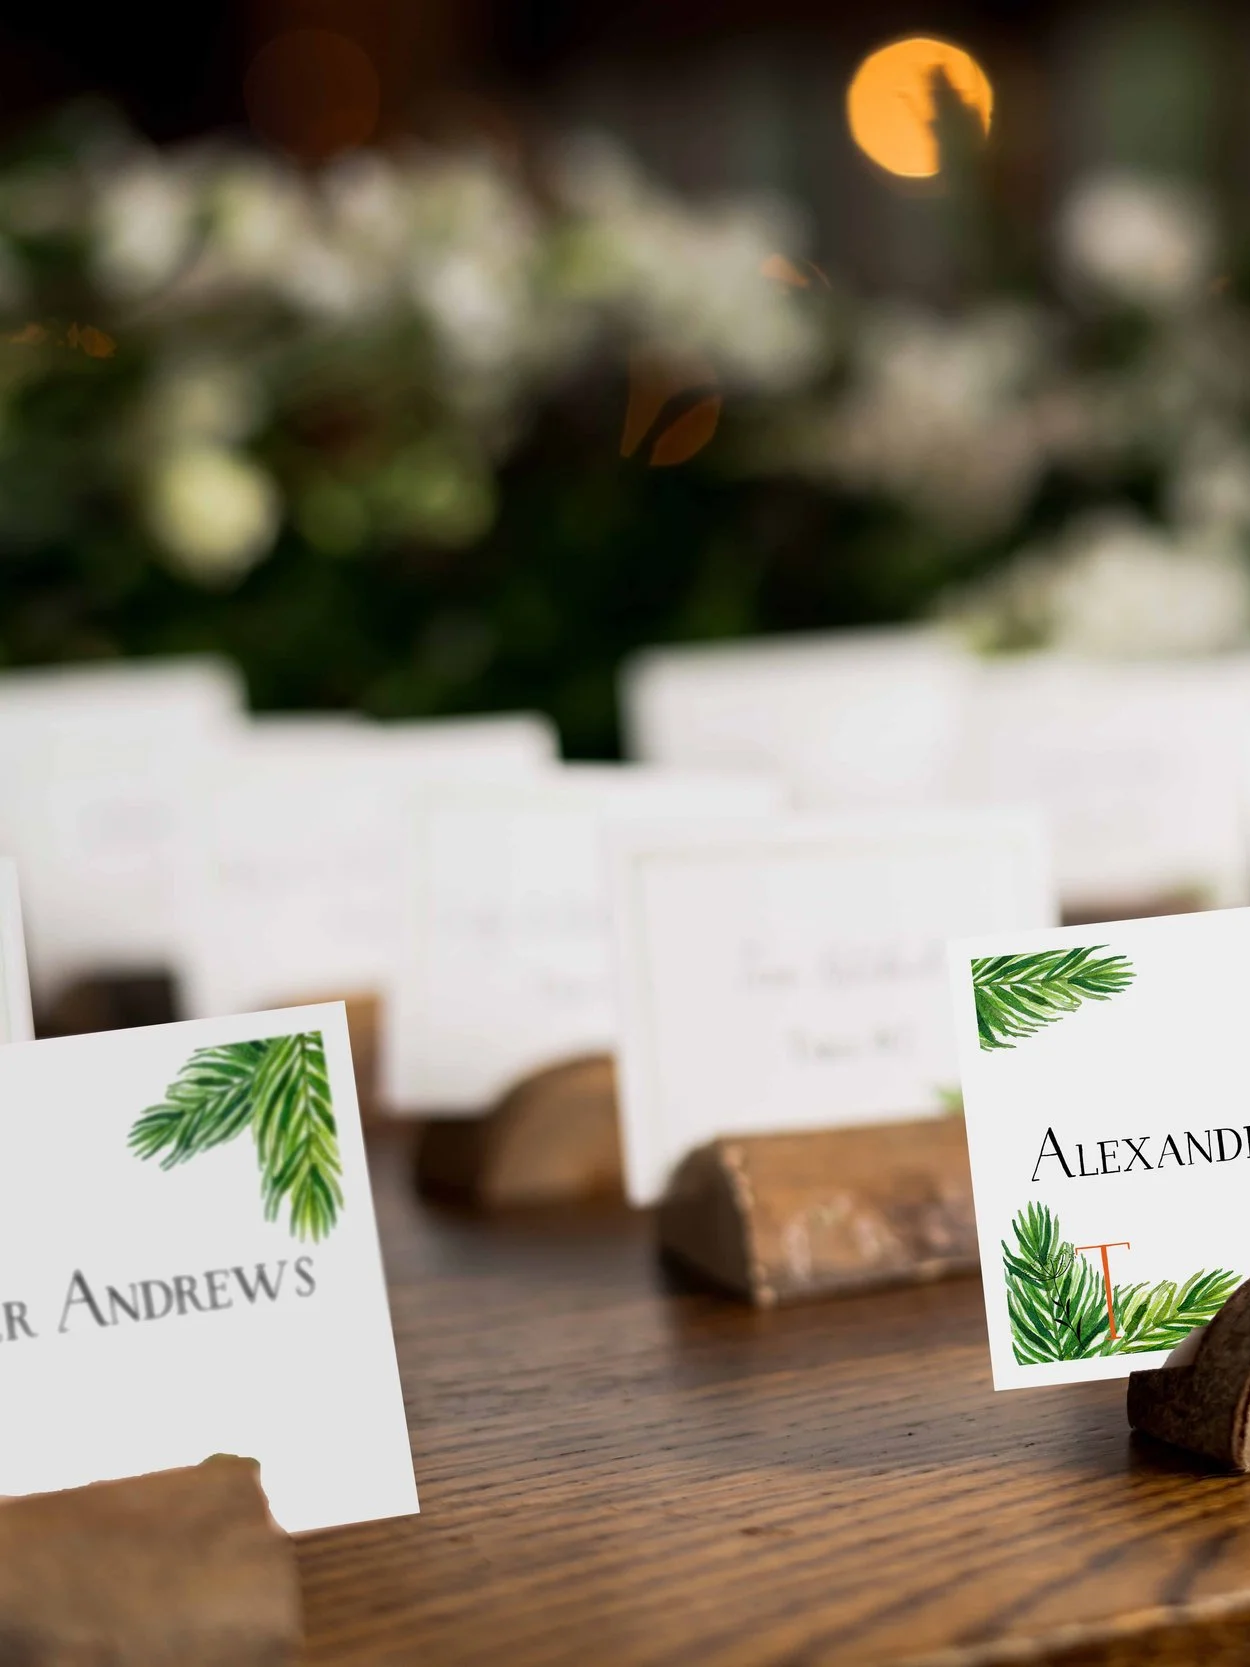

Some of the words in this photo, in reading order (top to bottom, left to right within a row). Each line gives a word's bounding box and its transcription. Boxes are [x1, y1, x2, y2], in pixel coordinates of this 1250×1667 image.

[0, 1300, 39, 1343] R
[57, 1255, 317, 1334] ANDREWS
[1074, 1242, 1130, 1341] T
